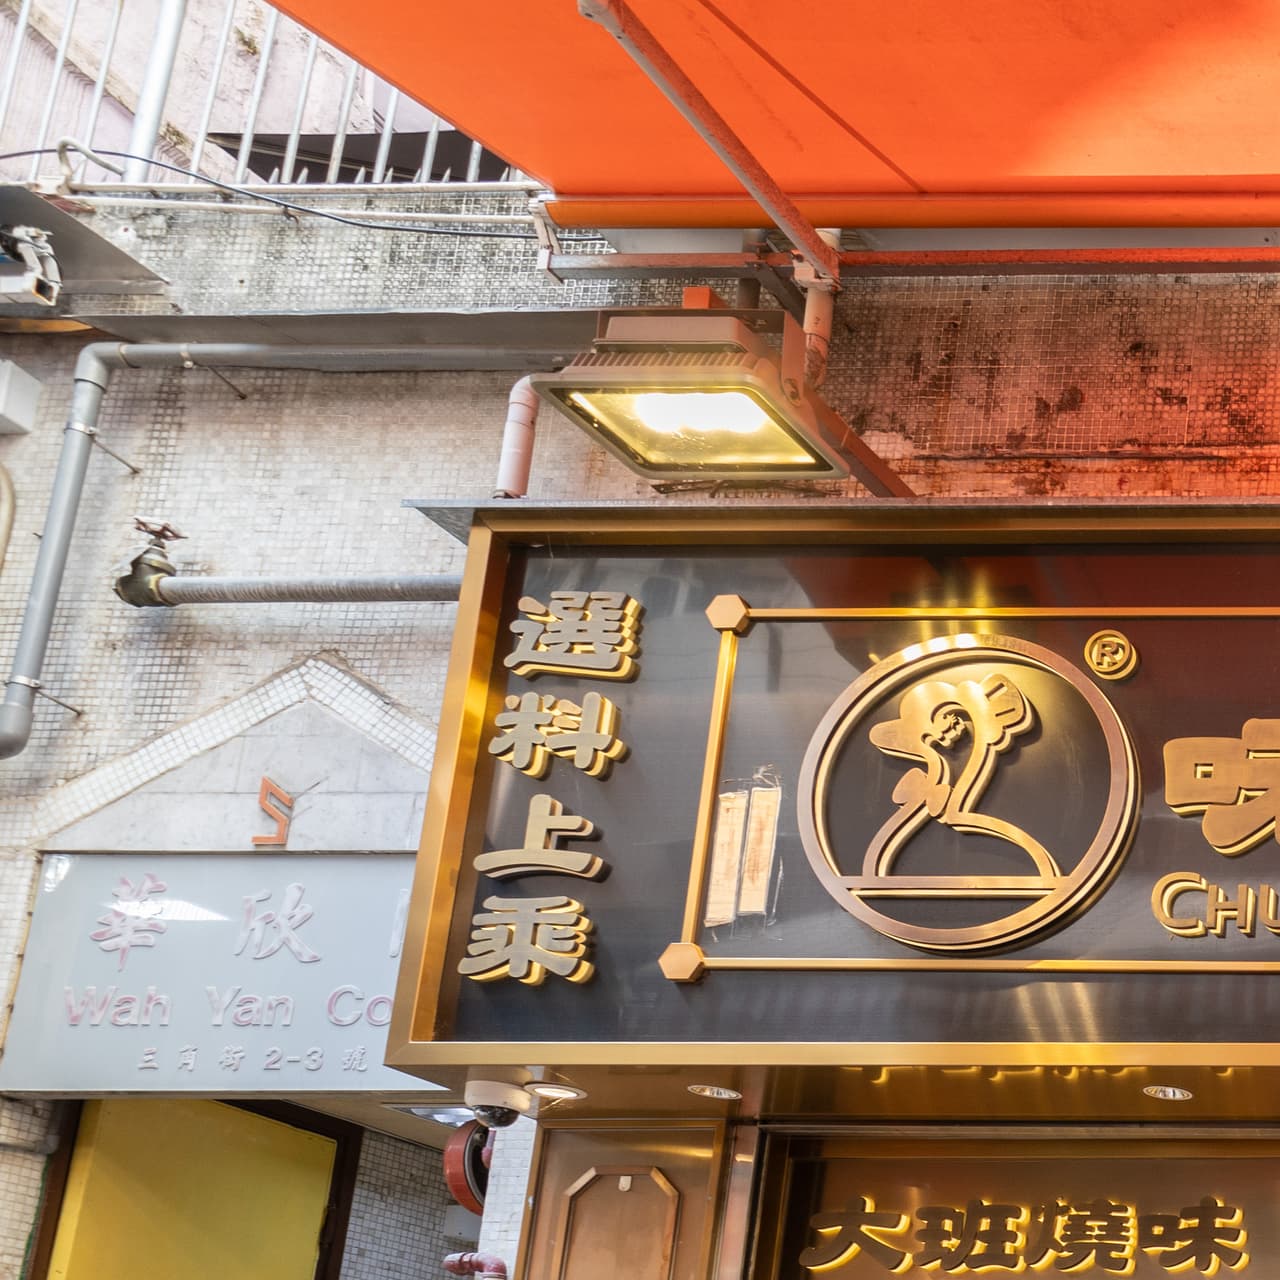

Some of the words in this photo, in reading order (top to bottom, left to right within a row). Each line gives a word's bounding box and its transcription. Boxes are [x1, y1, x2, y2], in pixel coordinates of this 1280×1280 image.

[458, 590, 646, 986] 選料上乘
[89, 873, 409, 972] 華欣
[64, 985, 171, 1026] Wah
[205, 985, 295, 1026] Yan
[801, 1196, 1250, 1275] 大班燒味
